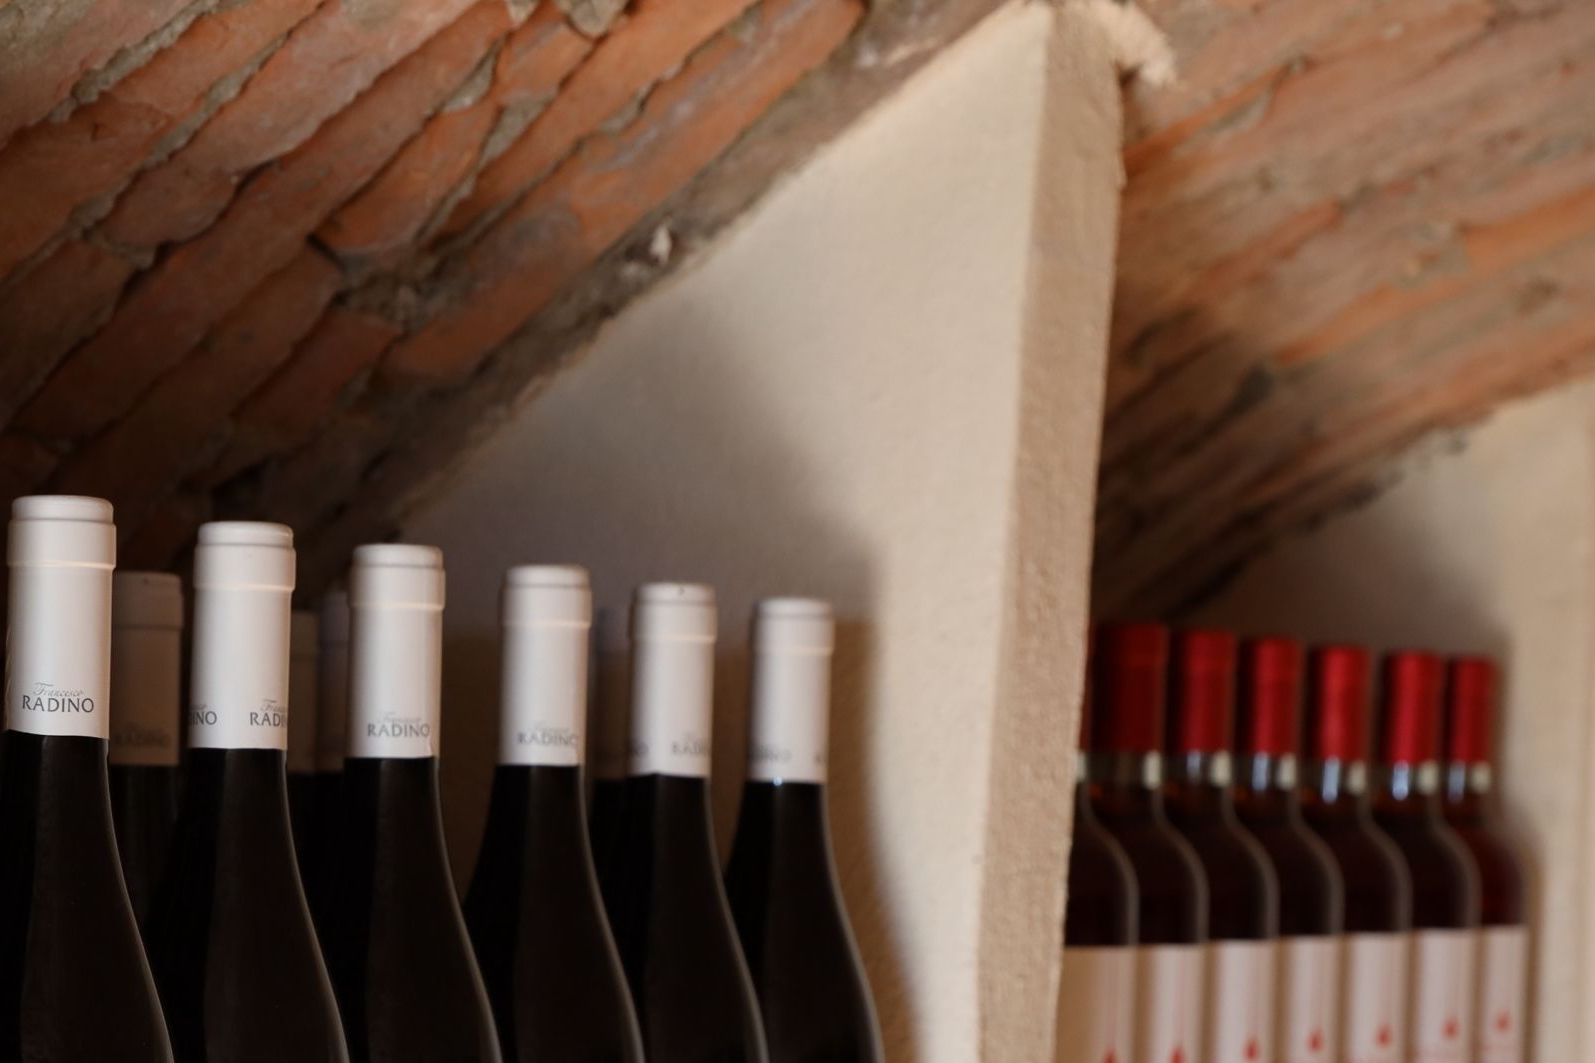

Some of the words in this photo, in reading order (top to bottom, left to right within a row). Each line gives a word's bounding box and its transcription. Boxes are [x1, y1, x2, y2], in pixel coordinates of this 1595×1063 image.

[32, 681, 85, 698] Francesco
[22, 695, 95, 713] RADINO
[367, 723, 430, 737] RADINO
